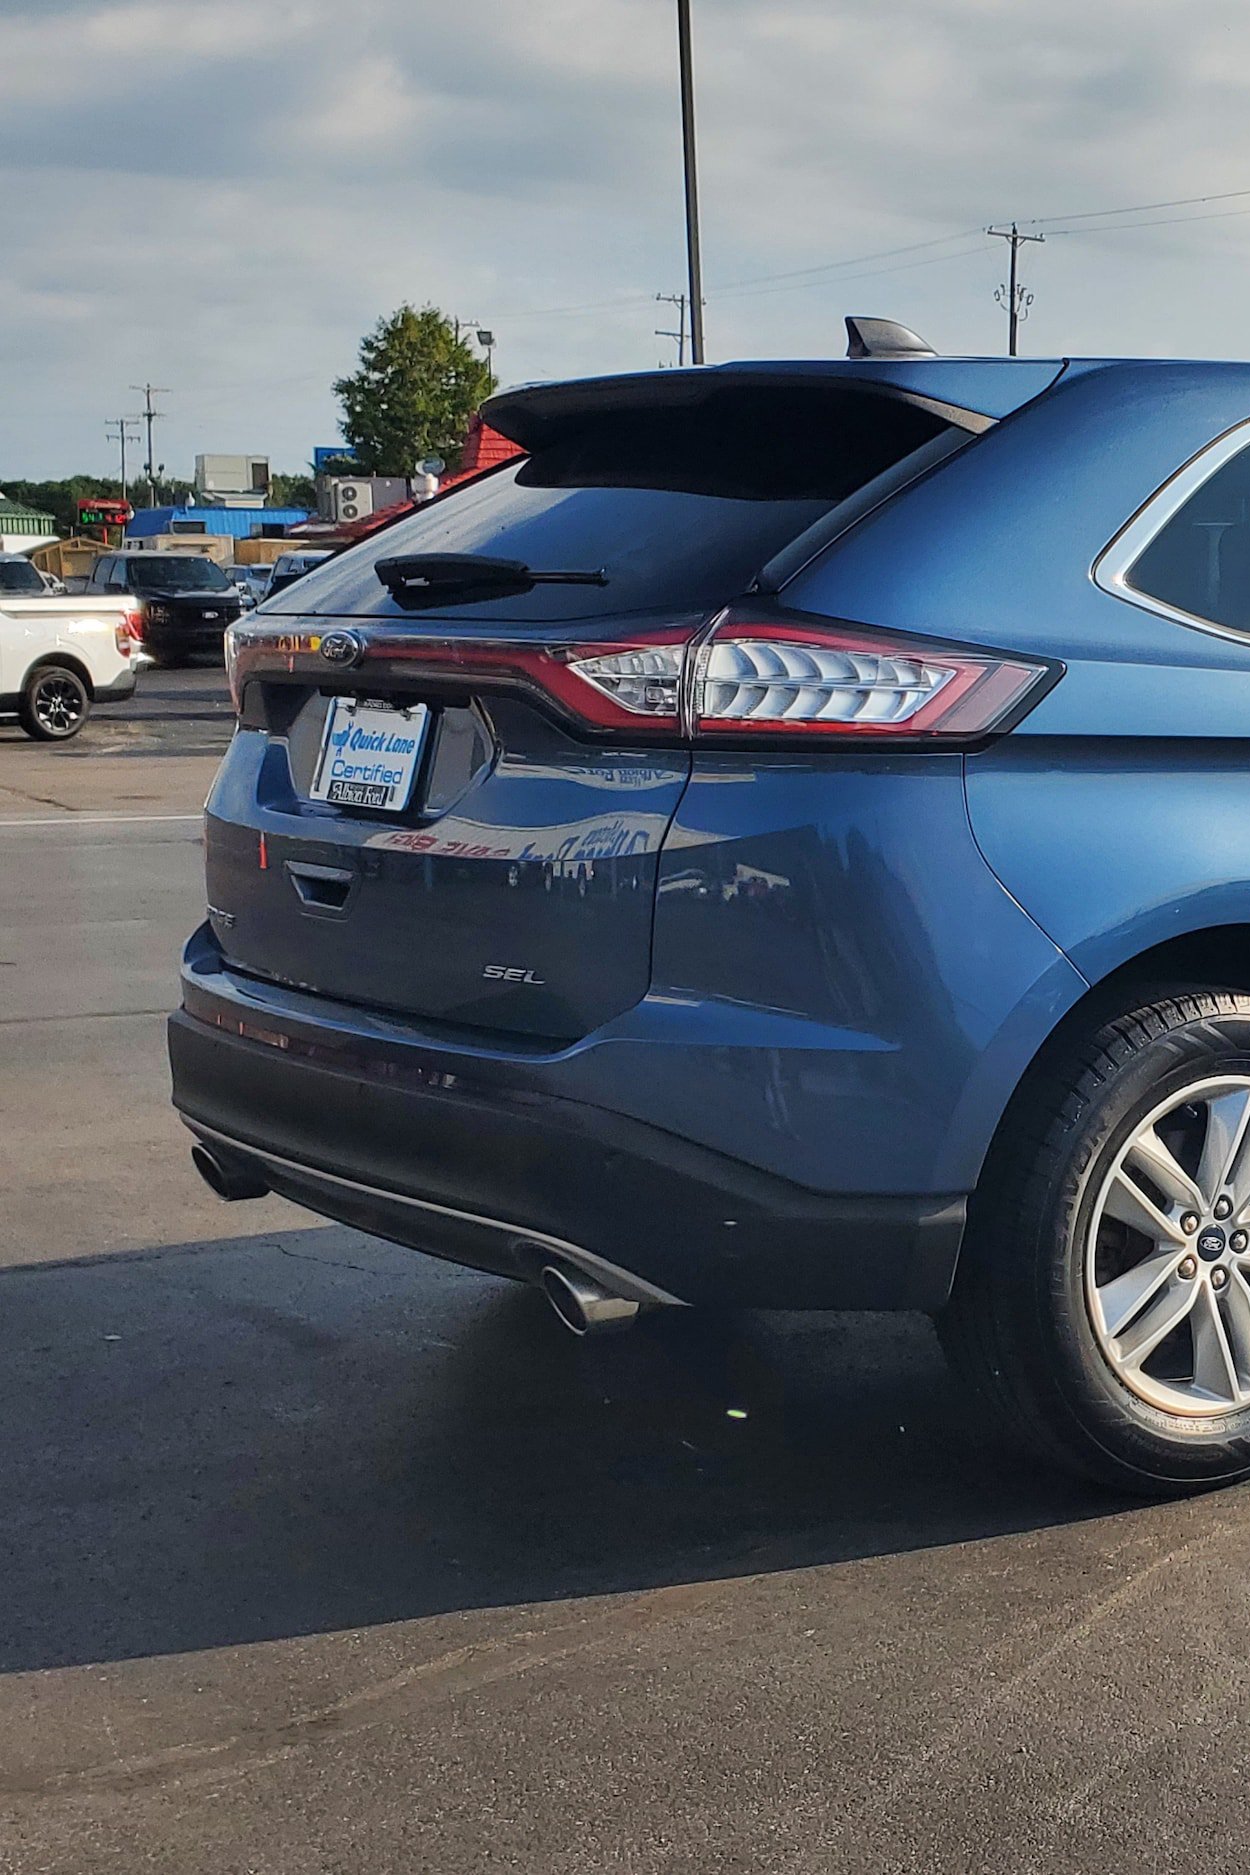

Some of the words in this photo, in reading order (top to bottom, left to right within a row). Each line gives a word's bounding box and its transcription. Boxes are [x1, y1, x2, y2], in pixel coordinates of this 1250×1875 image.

[350, 728, 386, 752] Quick
[385, 733, 416, 754] Lane
[331, 760, 404, 784] Certified
[483, 965, 546, 984] SEL
